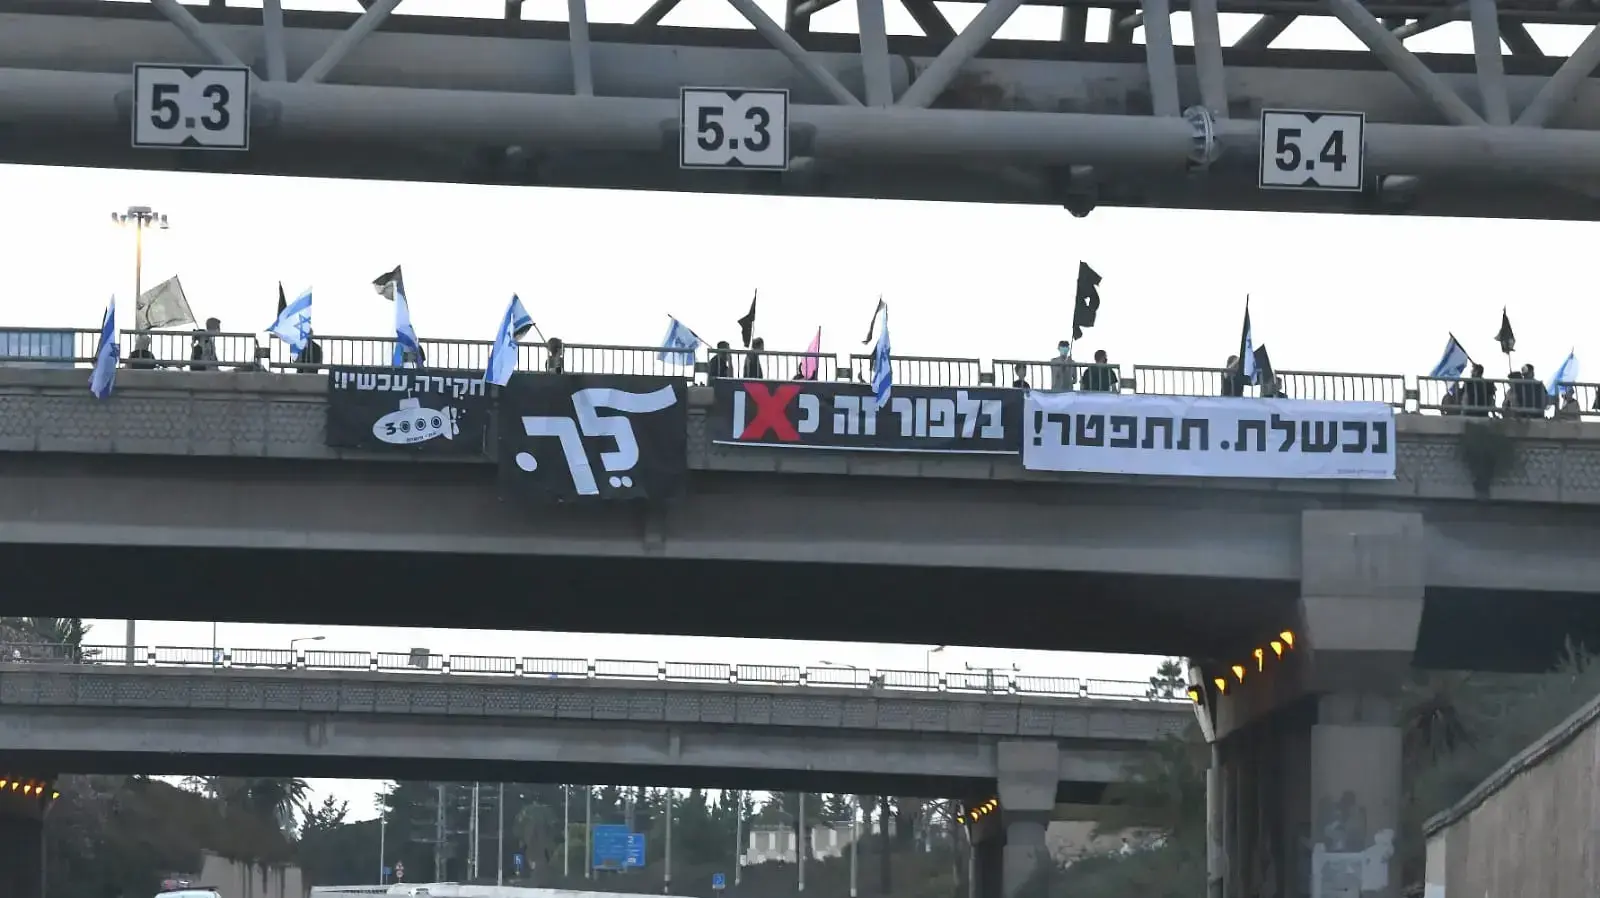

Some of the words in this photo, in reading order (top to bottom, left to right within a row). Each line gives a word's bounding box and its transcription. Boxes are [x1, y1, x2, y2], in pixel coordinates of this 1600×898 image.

[150, 83, 230, 131] 5.3
[697, 106, 771, 152] 5.3
[1275, 127, 1347, 172] 5.4
[334, 371, 409, 392] עכשיו!
[414, 375, 486, 398] חקירה
[833, 395, 880, 436] זה
[892, 390, 1004, 439] בלפור
[1033, 410, 1210, 451] תתפטר!
[1219, 413, 1388, 454] נכשלת.
